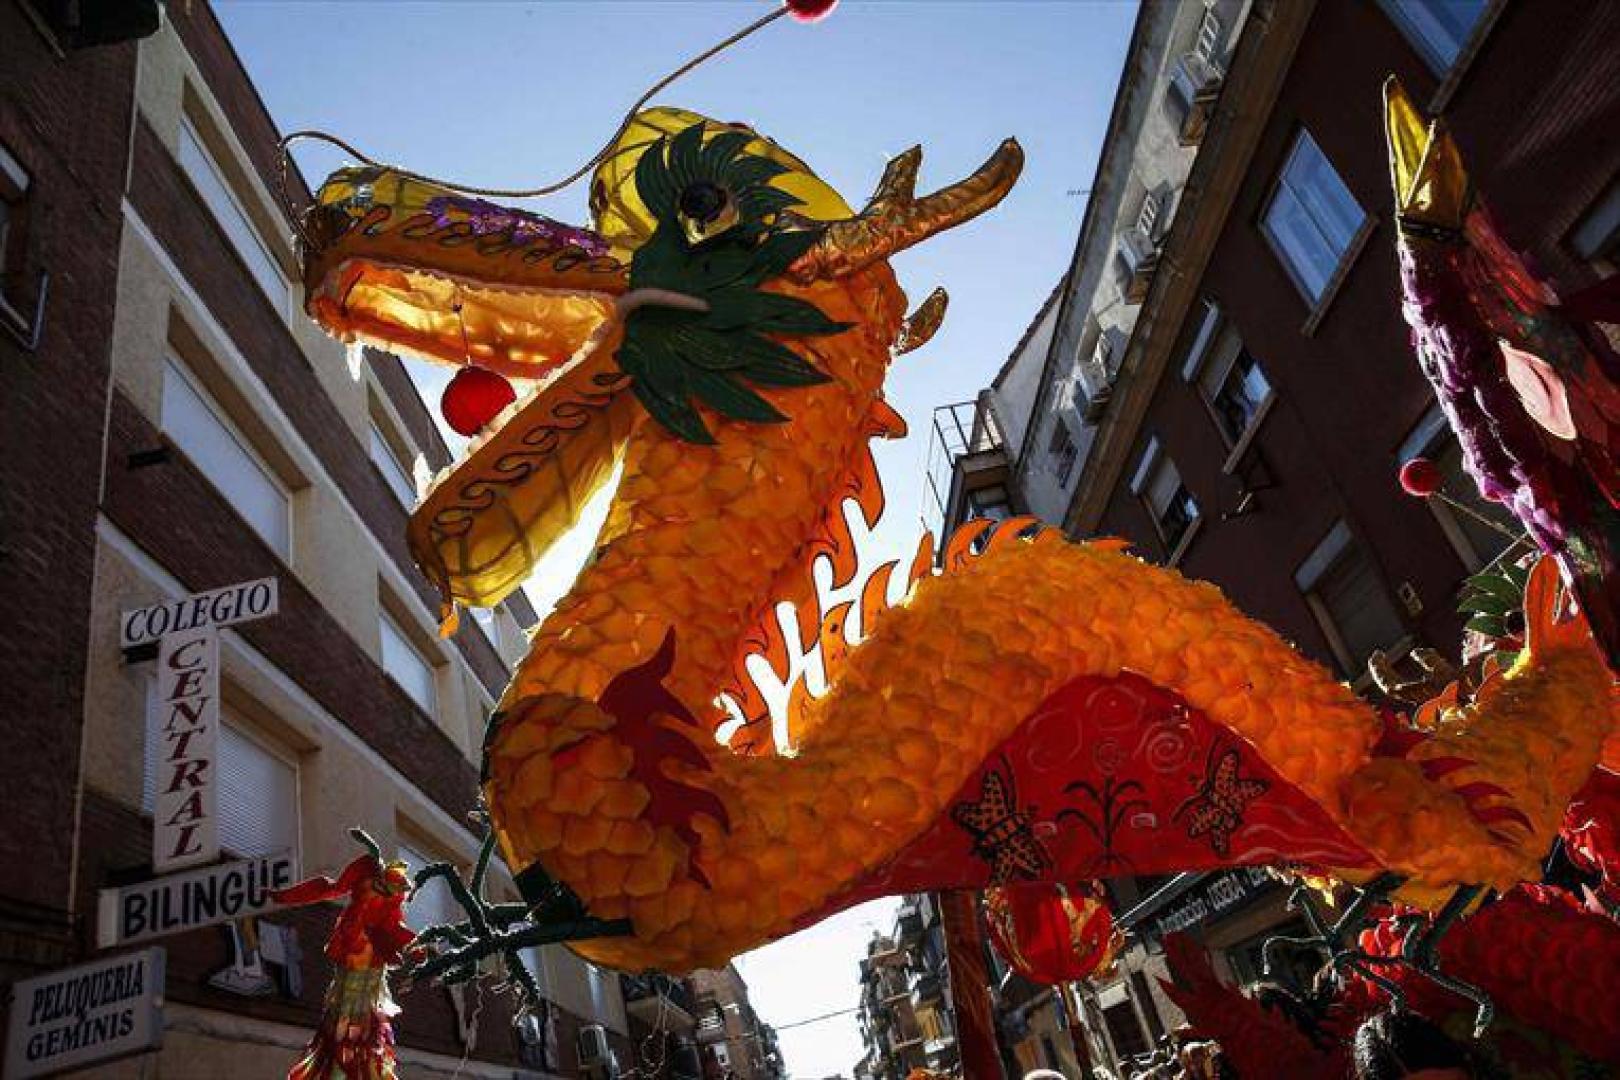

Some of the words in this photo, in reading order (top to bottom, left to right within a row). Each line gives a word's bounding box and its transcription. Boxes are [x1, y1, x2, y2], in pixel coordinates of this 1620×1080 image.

[125, 583, 271, 642] COLEGIO
[165, 638, 209, 859] CENTRAL
[29, 961, 143, 1025] PELUQUERIA
[27, 1009, 134, 1060] GEMINIS
